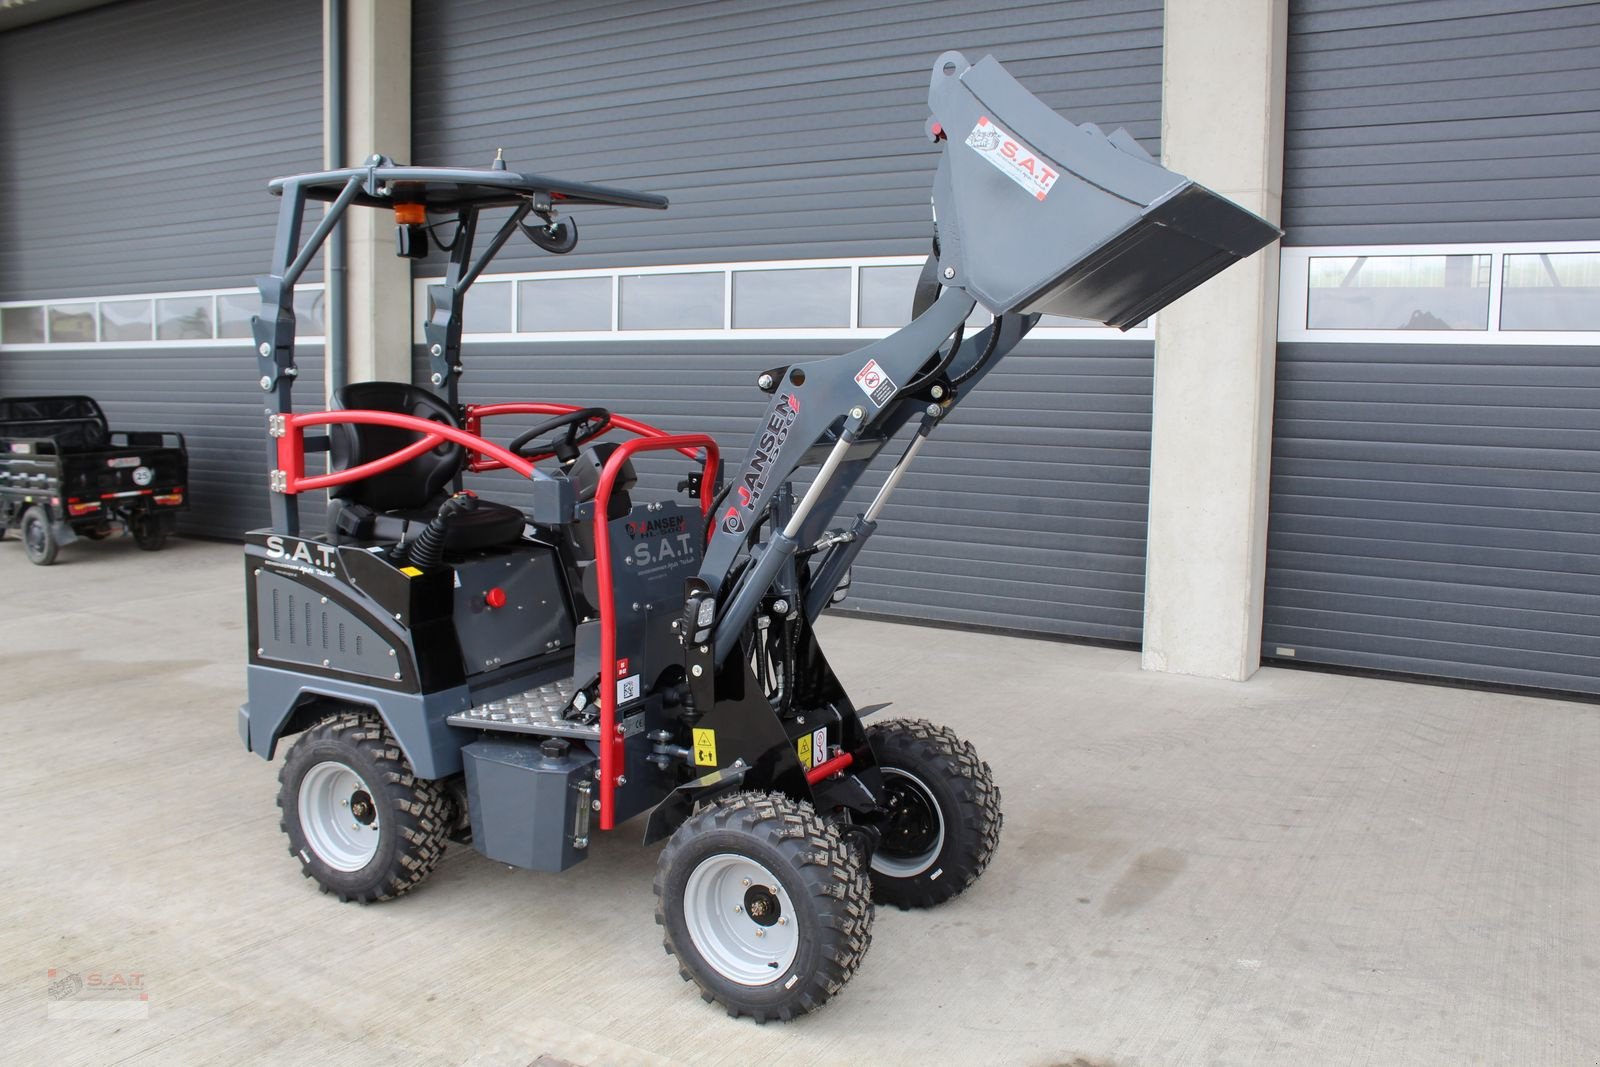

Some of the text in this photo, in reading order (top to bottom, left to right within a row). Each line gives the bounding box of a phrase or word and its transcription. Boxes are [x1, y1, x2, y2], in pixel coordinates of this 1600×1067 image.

[1000, 141, 1055, 187] S.A.T.
[738, 394, 789, 507] JANSEN
[136, 472, 149, 482] 25
[640, 515, 684, 534] JANSEN
[266, 536, 336, 569] S.A.T.
[634, 533, 693, 566] S.A.T.
